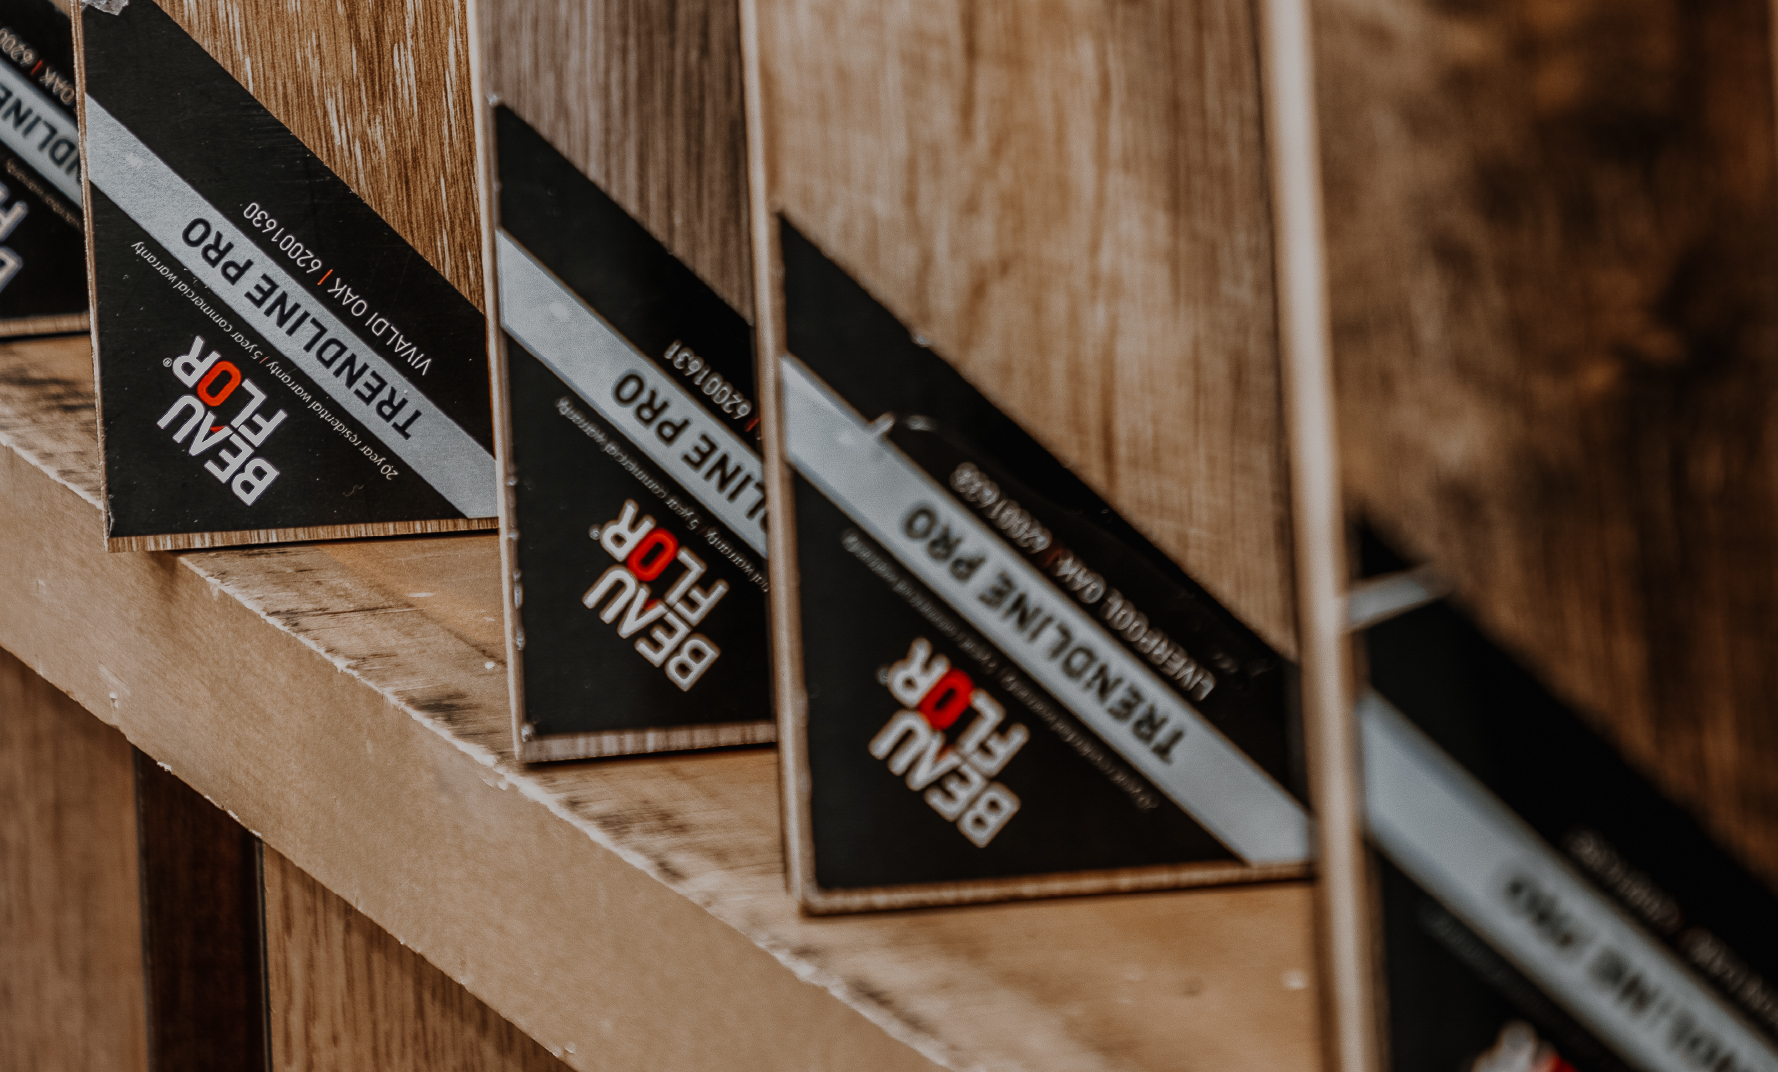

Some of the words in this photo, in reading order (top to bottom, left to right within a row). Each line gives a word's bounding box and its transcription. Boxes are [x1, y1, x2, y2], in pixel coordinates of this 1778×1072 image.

[128, 239, 180, 285] warranty
[177, 213, 254, 286] PRO
[241, 200, 324, 277] 62001630
[172, 279, 234, 336] commercial
[326, 276, 371, 319] OAK
[230, 328, 258, 355] year
[244, 273, 422, 441] TRENDLINE
[364, 311, 432, 376] VIVALDI
[264, 359, 314, 404] warranty
[607, 368, 693, 450] PRO
[662, 338, 755, 424] 62001631
[307, 399, 363, 450] residential
[358, 441, 387, 468] year
[378, 462, 399, 482] 20
[896, 499, 988, 587] PRO
[976, 569, 1188, 767] TRENDLINE
